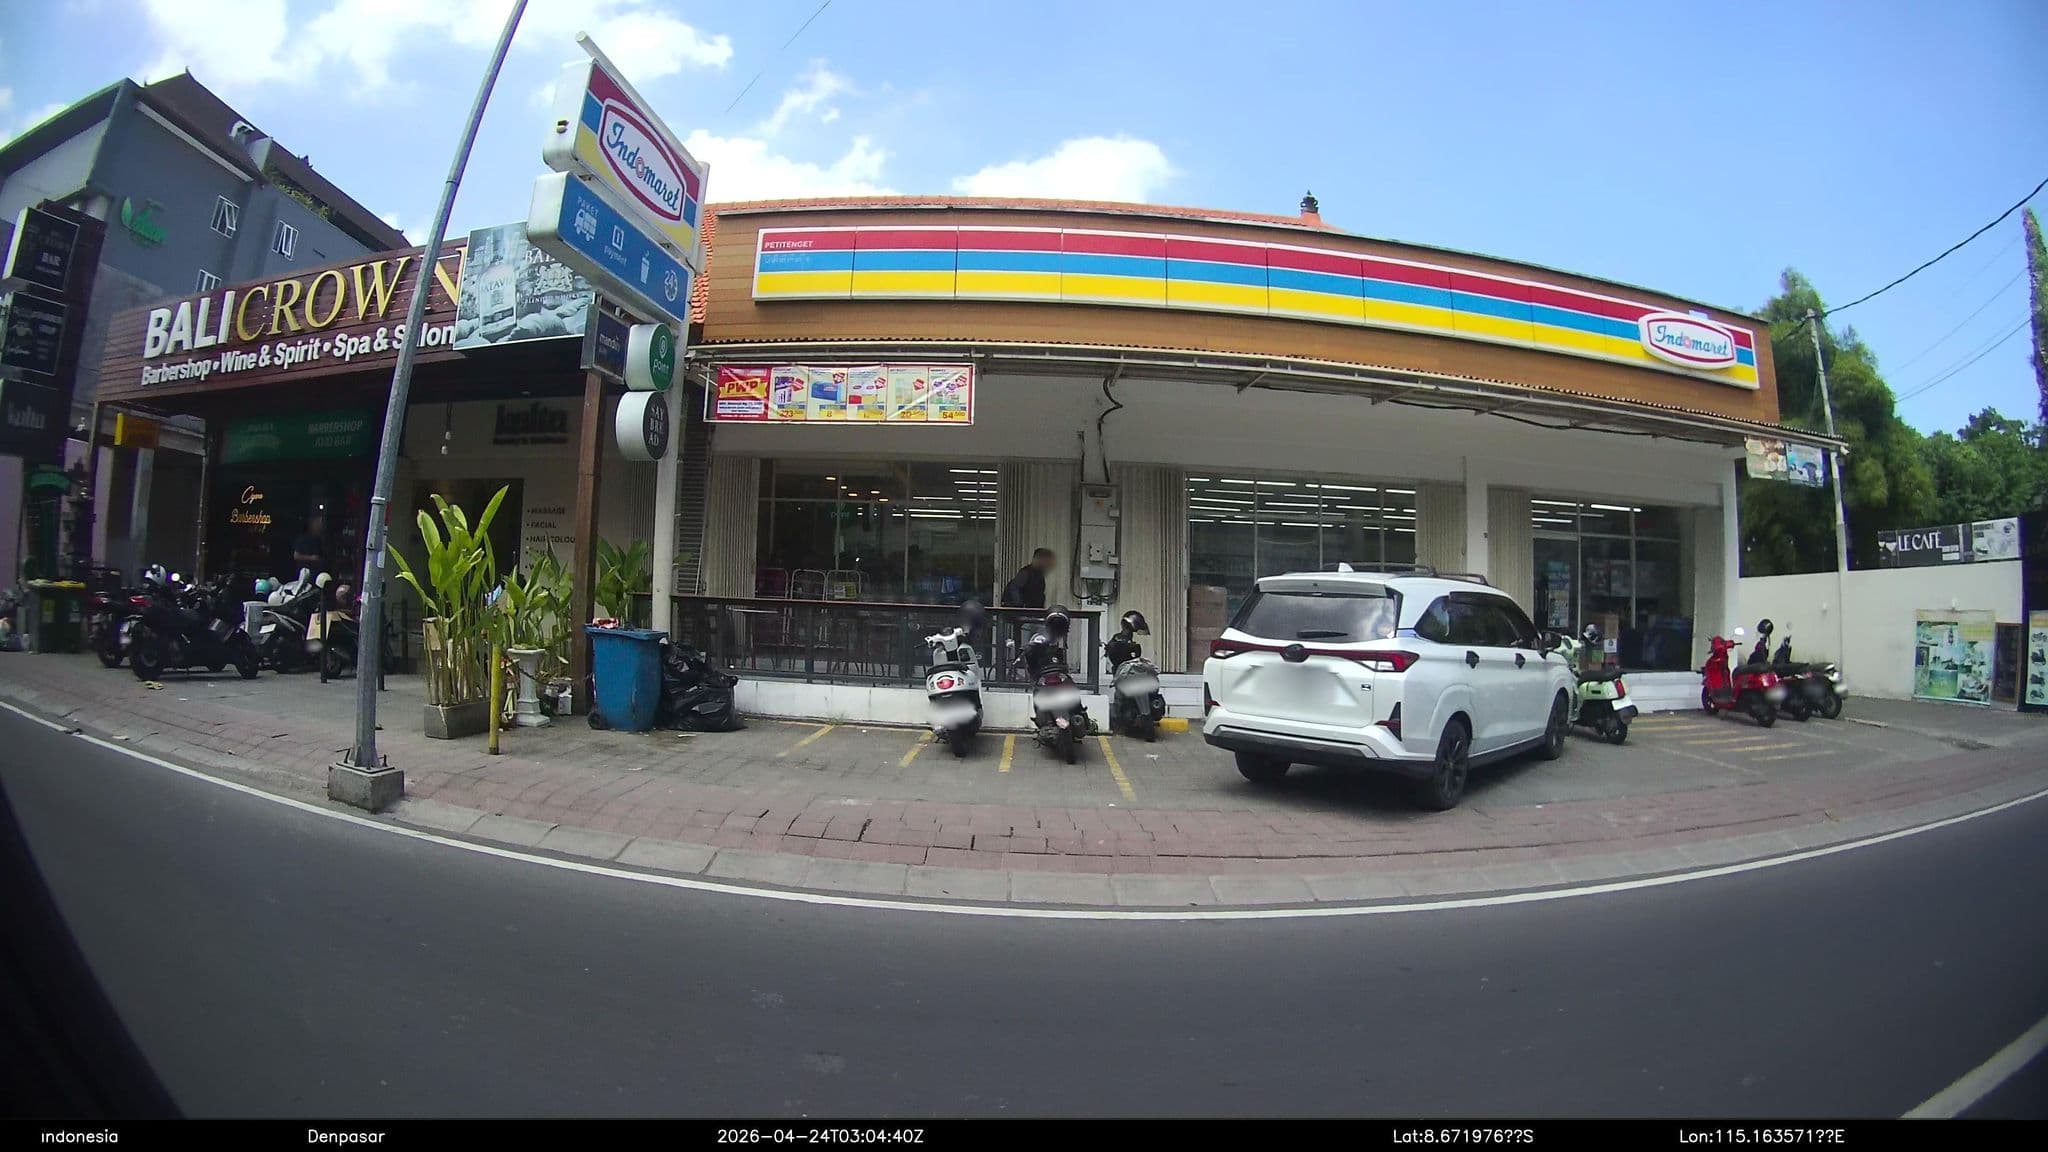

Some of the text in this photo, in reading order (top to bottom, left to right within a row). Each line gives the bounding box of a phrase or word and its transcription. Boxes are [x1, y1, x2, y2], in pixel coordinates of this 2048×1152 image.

[607, 121, 680, 211] Indomaret
[577, 195, 599, 217] PAKET
[765, 240, 814, 249] PETITENGET
[1655, 324, 1728, 356] Indomaret
[141, 322, 455, 386] Barbershop Wine & Spirit Spa & Slon
[531, 521, 557, 529] FACIAL
[1898, 534, 1911, 552] LE
